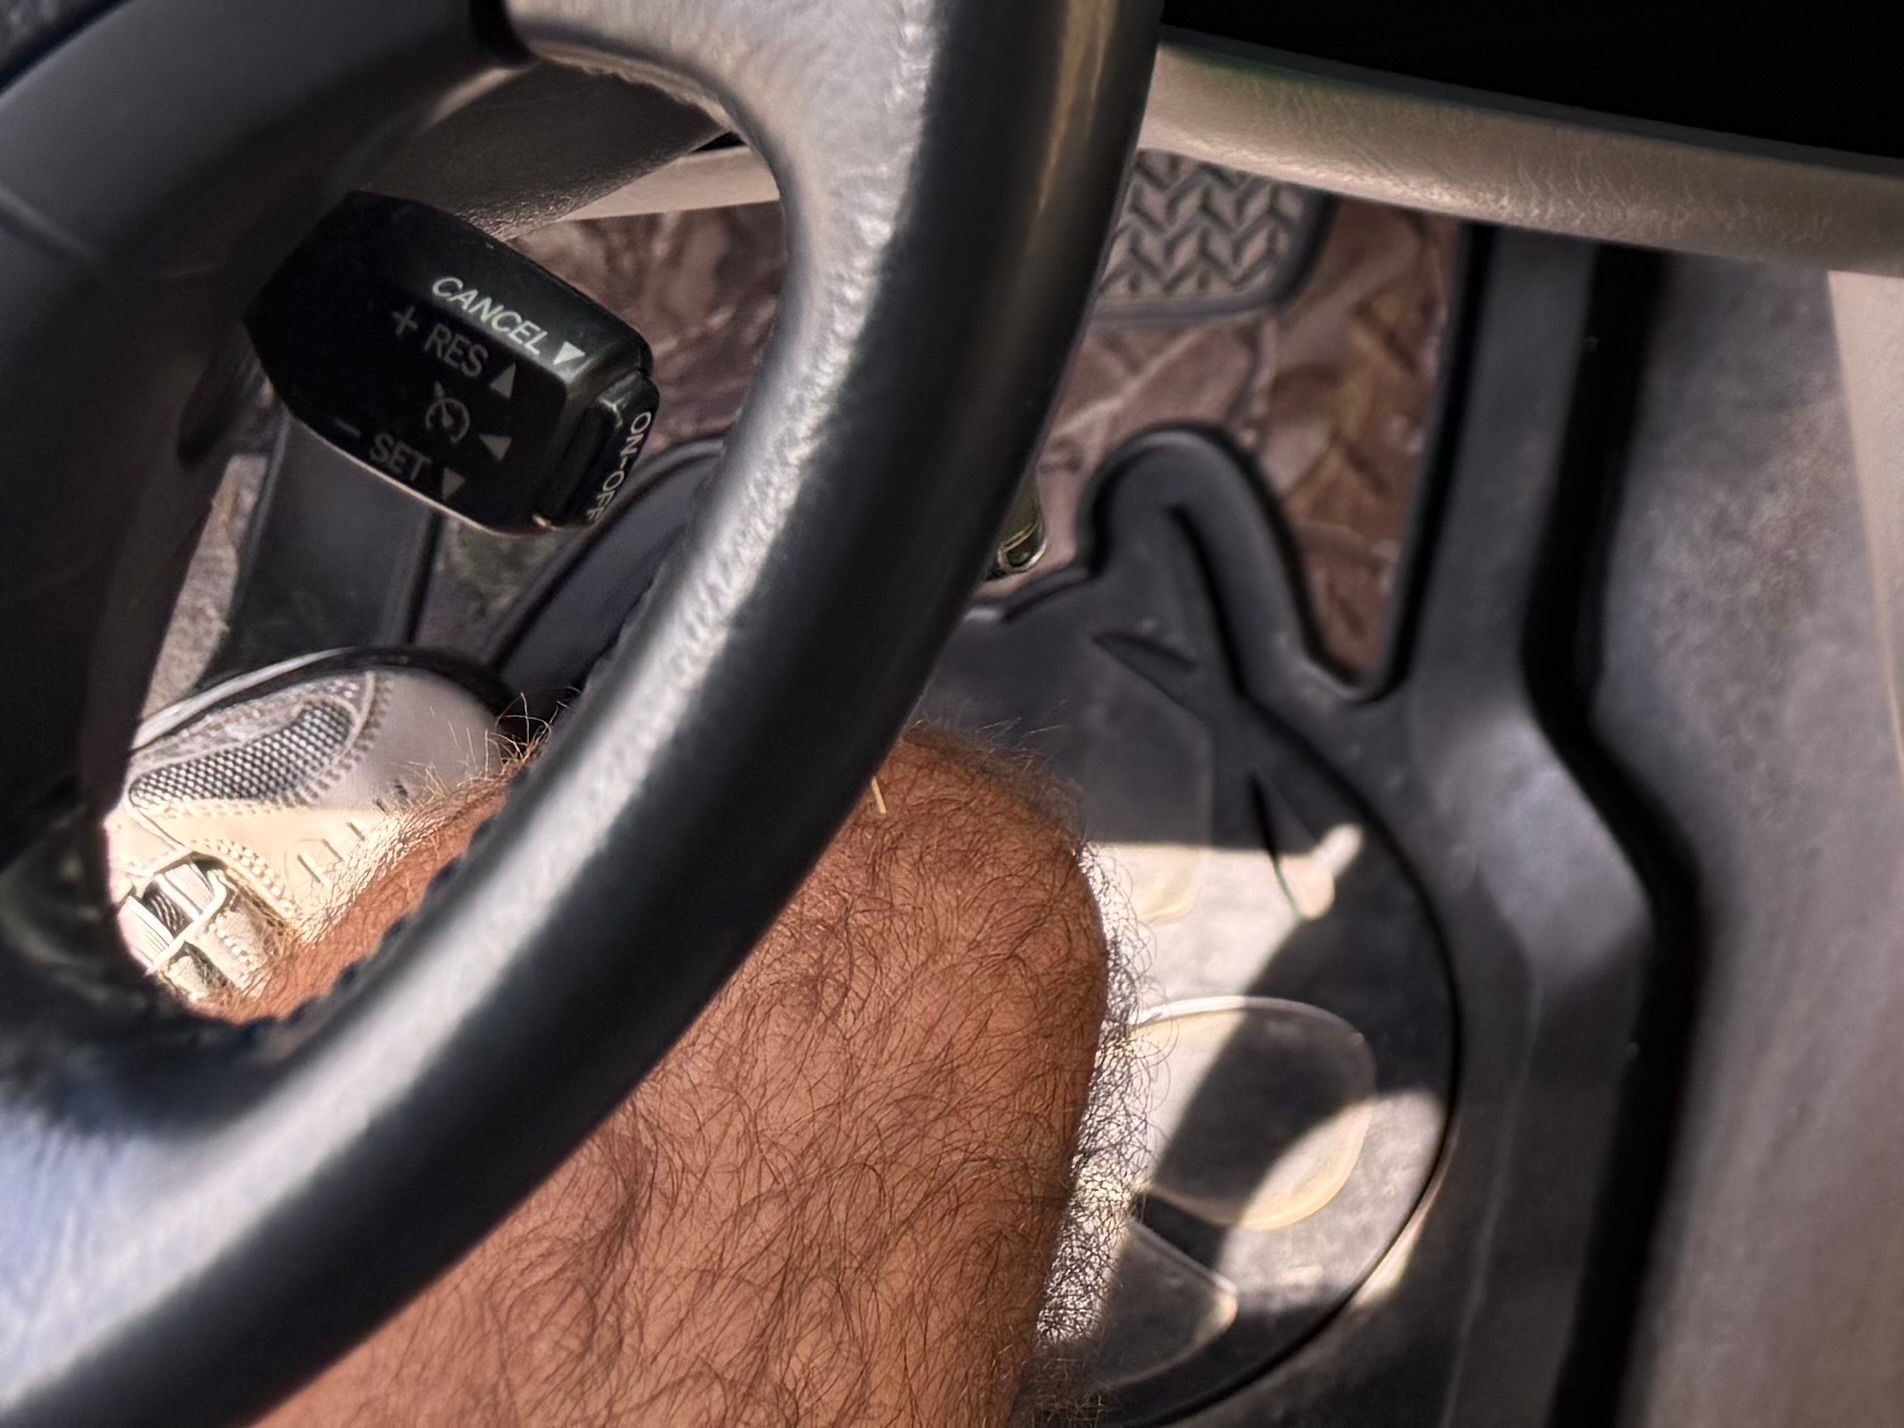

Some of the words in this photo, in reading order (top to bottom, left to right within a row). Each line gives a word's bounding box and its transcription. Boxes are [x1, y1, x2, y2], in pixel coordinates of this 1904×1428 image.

[432, 275, 552, 358] CANCEL
[425, 325, 488, 379] RES
[368, 432, 431, 483] SET
